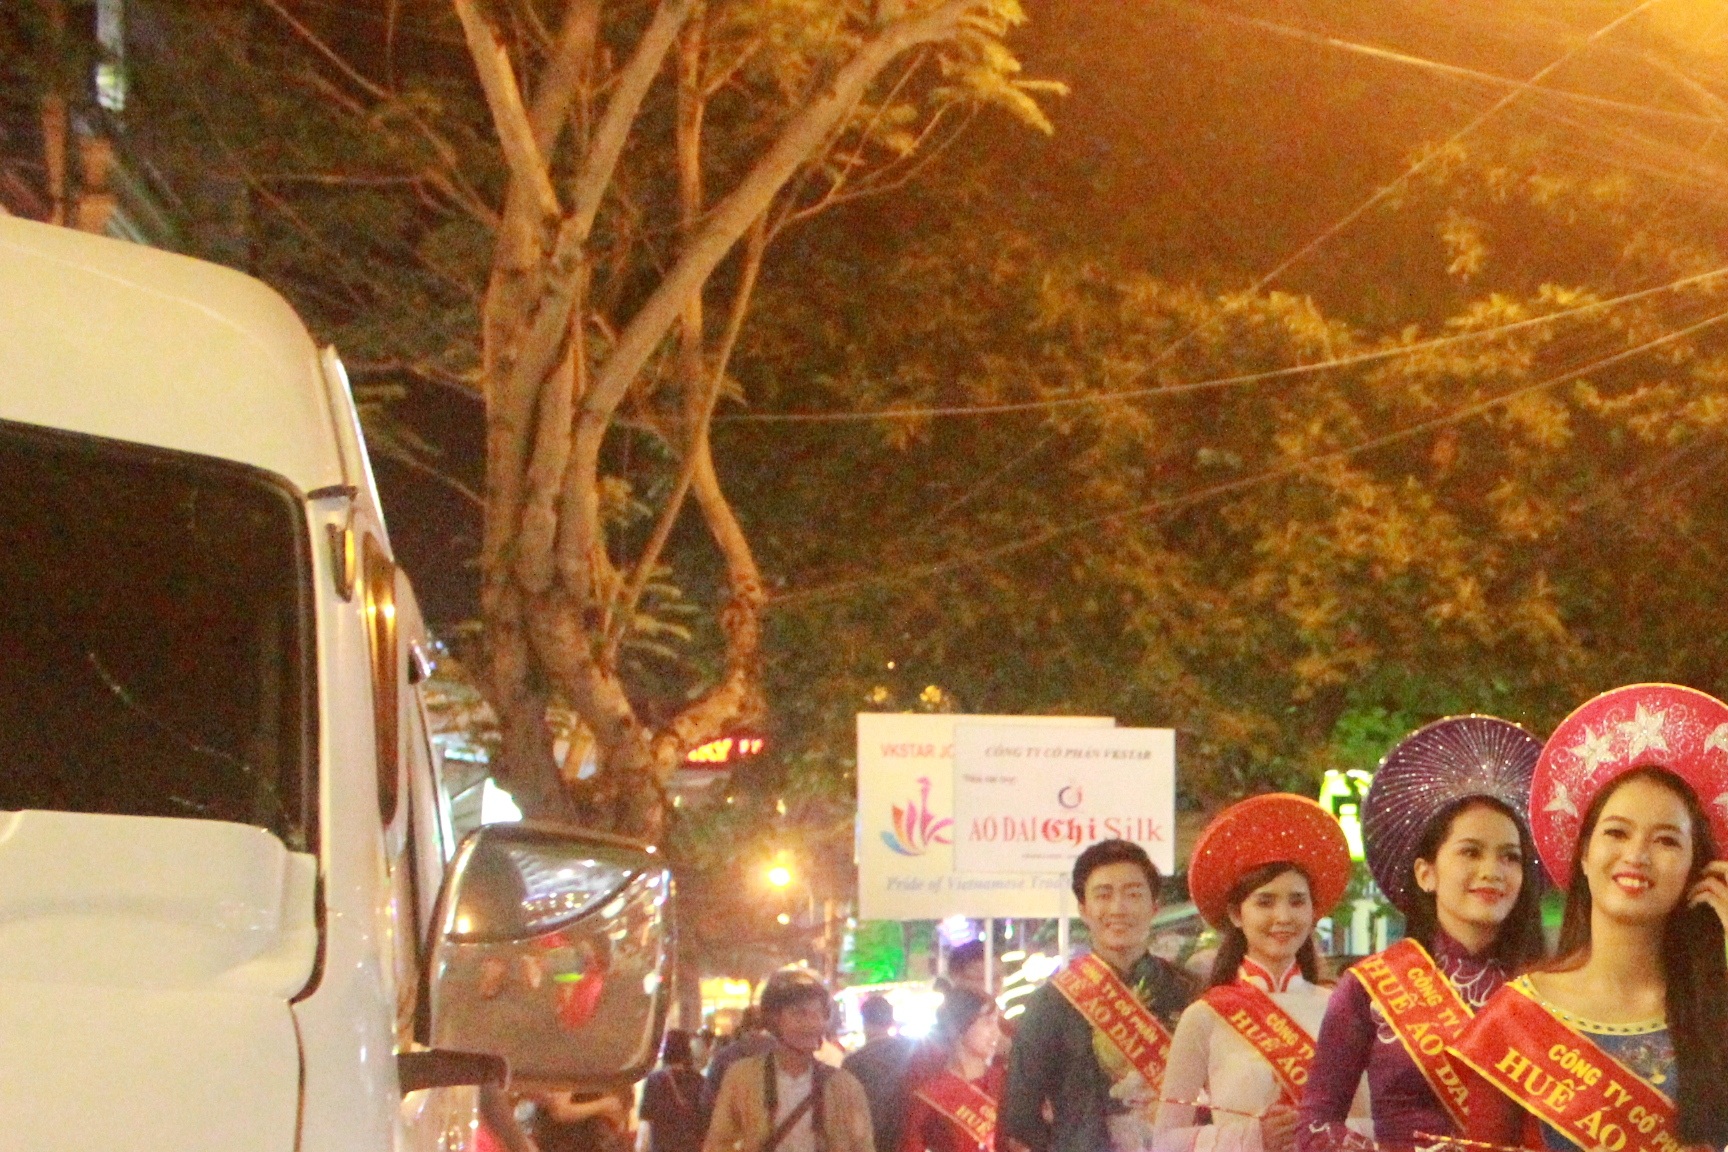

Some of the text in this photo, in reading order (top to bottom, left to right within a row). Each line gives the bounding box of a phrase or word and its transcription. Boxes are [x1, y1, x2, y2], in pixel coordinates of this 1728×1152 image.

[881, 743, 935, 759] VKSTAR
[1362, 953, 1427, 1015] HUẾ
[1437, 1006, 1461, 1028] TY
[1495, 1046, 1587, 1113] HUẾ
[1573, 1105, 1627, 1151] ÁO
[1548, 1043, 1602, 1087] CÔNG
[1603, 1079, 1632, 1108] TY
